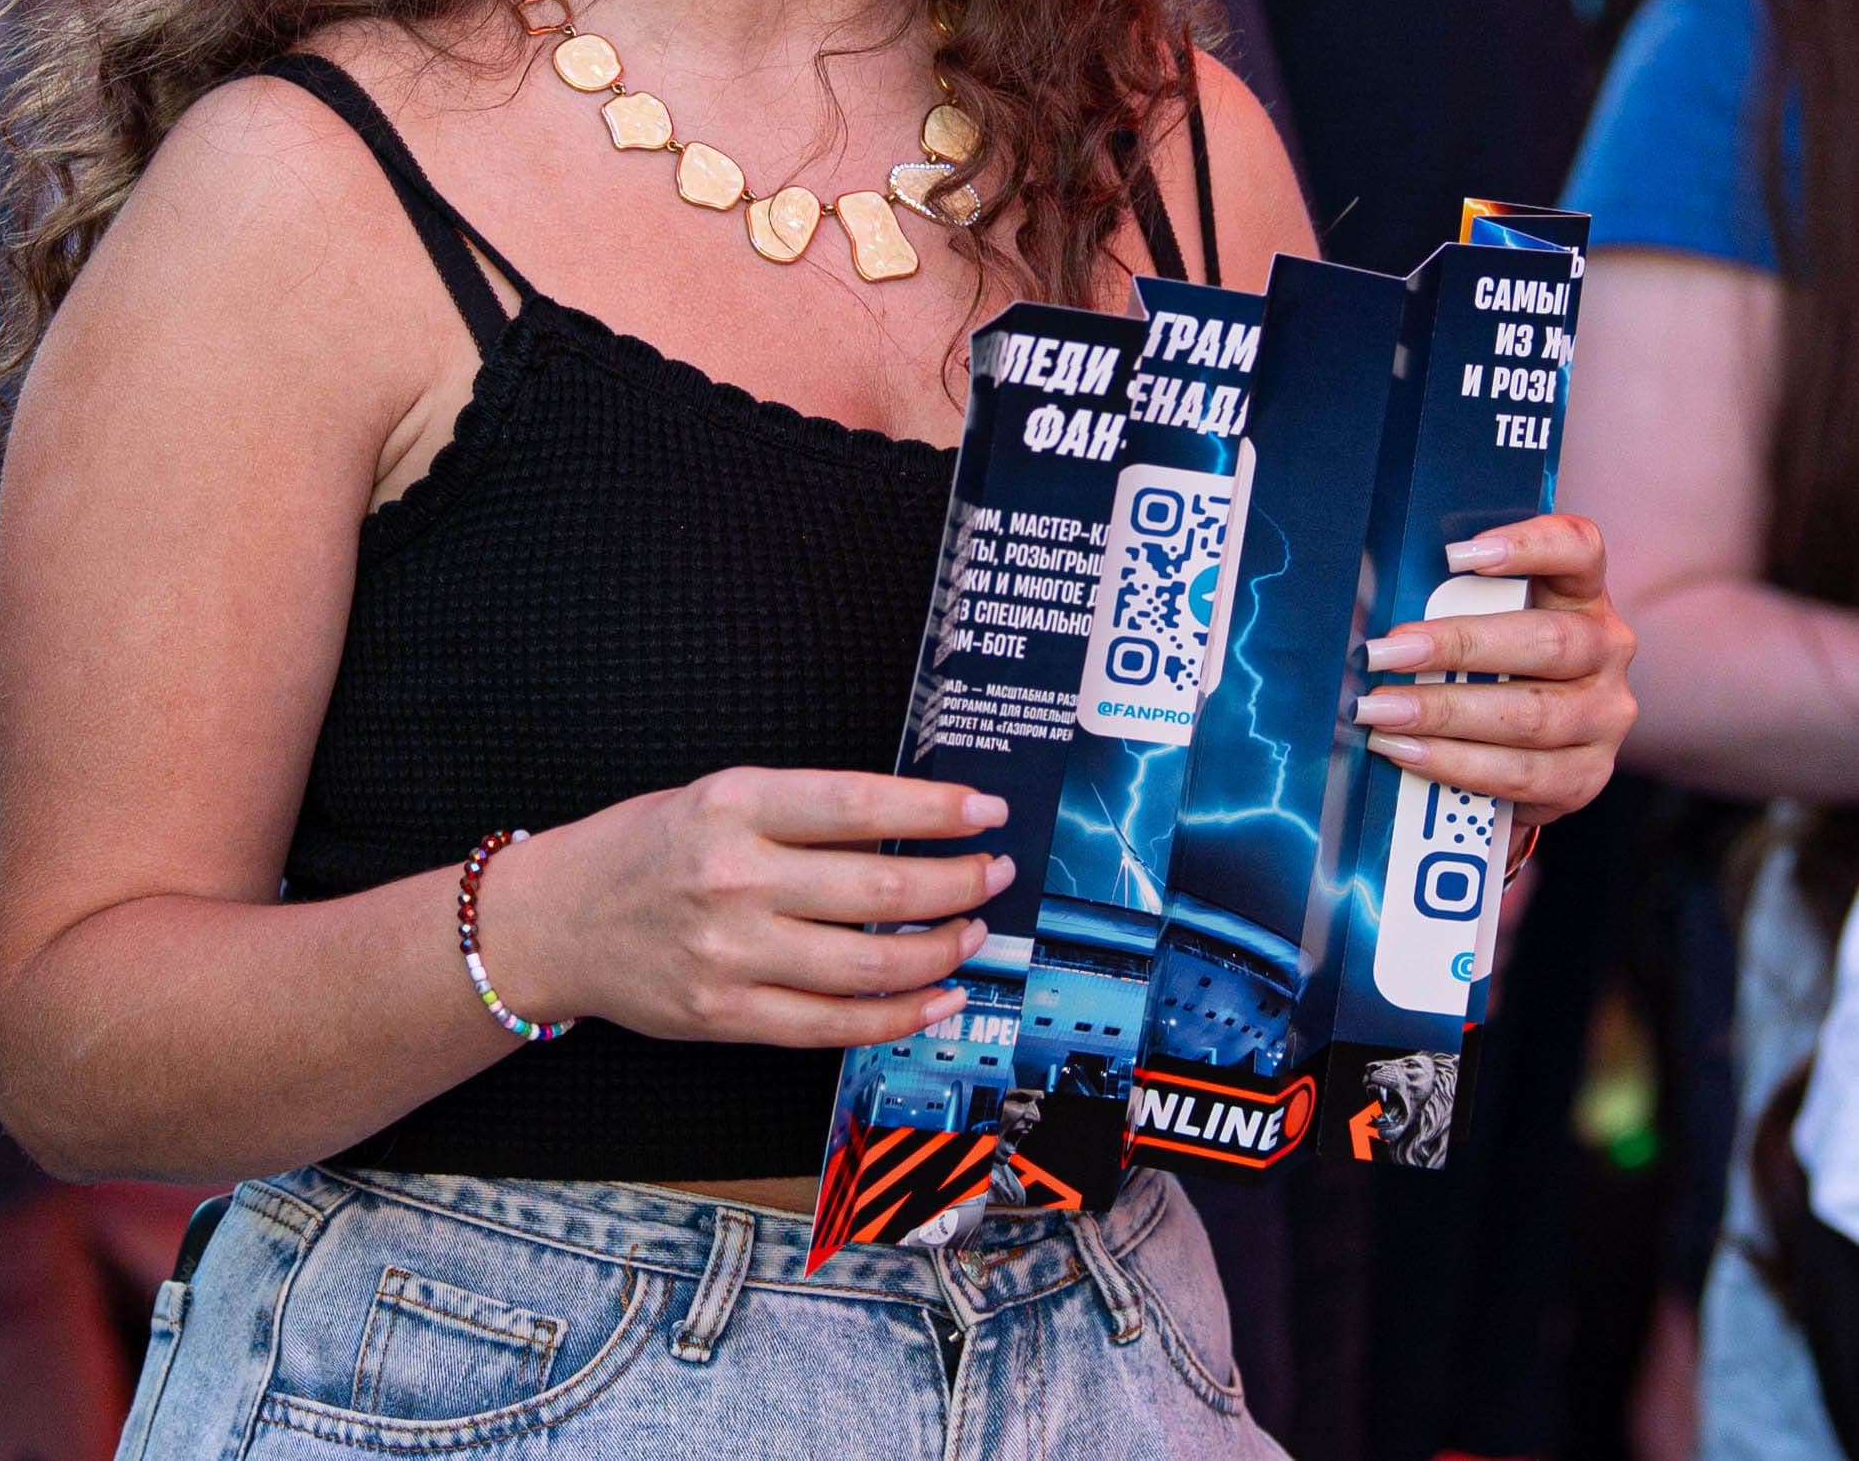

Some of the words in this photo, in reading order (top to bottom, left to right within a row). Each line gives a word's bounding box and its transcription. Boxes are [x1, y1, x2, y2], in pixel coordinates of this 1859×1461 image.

[1475, 276, 1570, 316] САМЫ
[996, 332, 1121, 396] ЛЕДИ
[1135, 311, 1261, 373] ГРАМ
[1494, 322, 1535, 358] ИЗ
[1461, 363, 1484, 398] И
[973, 507, 1004, 537] ИМ,
[970, 538, 999, 567] ТЫ,
[965, 567, 992, 594] КИ
[995, 572, 1010, 596] И
[1013, 574, 1085, 606] МНОГОЕ
[974, 599, 1092, 637] СПЕЦИАЛЬНО
[986, 683, 1055, 703] МАСШТАБНАЯ
[1057, 693, 1078, 708] РАЗ
[999, 703, 1020, 718] ДЛЯ
[940, 714, 978, 732] АРТУЕТ
[980, 717, 993, 733] НА
[996, 721, 1048, 739] «ГАЗПРОМ
[1097, 701, 1193, 726] @FANPRO
[937, 732, 973, 748] ЖДОГО
[975, 736, 1012, 752] МАТЧА.
[1130, 1086, 1285, 1153] NLINE
